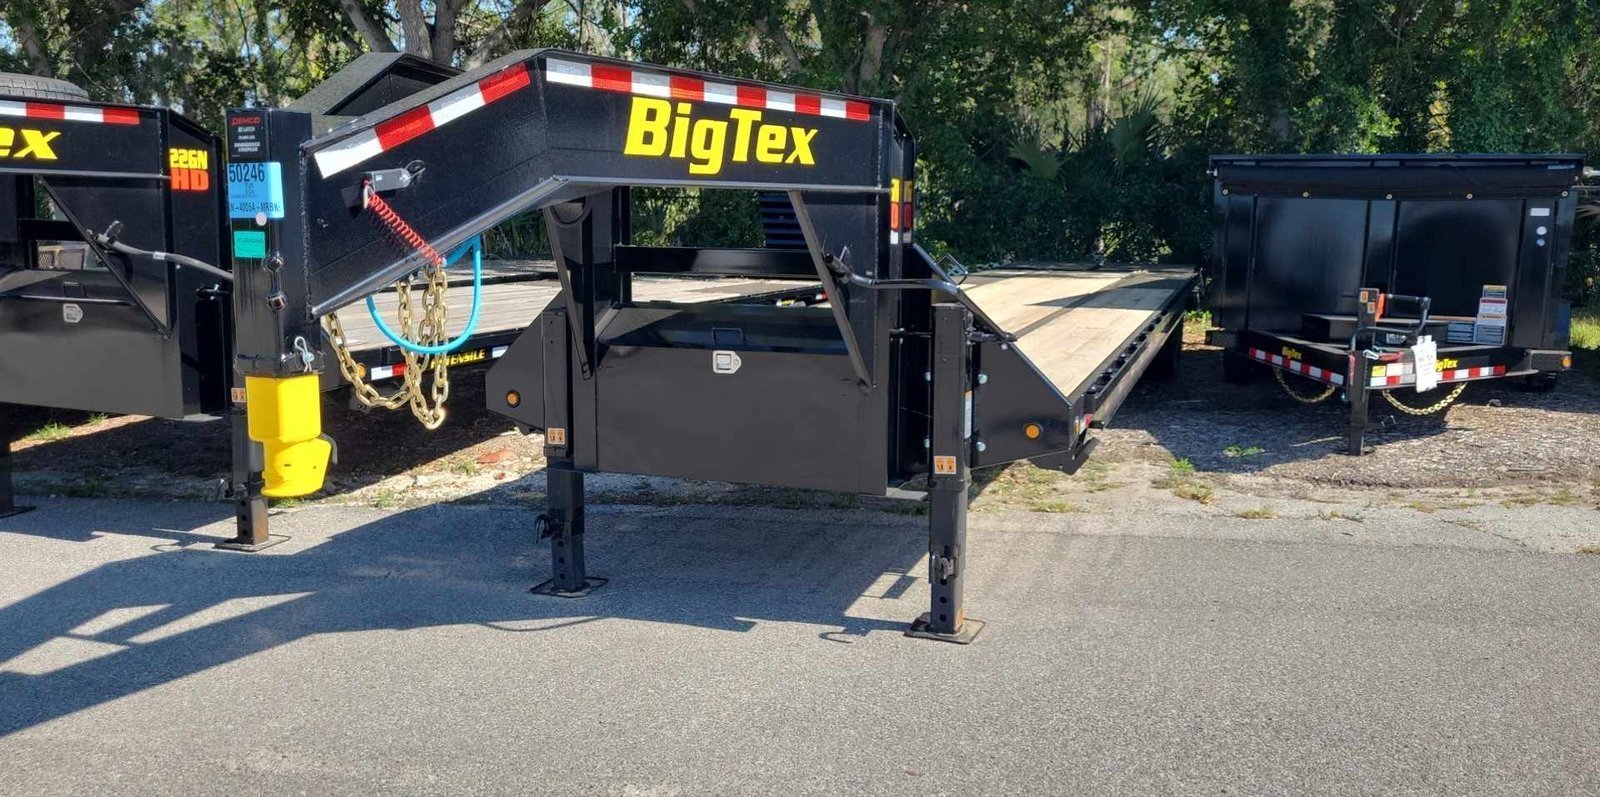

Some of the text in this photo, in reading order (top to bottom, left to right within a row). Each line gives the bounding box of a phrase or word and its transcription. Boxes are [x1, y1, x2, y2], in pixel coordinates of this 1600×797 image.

[624, 96, 818, 175] BigTex
[170, 168, 209, 190] HD
[228, 163, 266, 182] 50246
